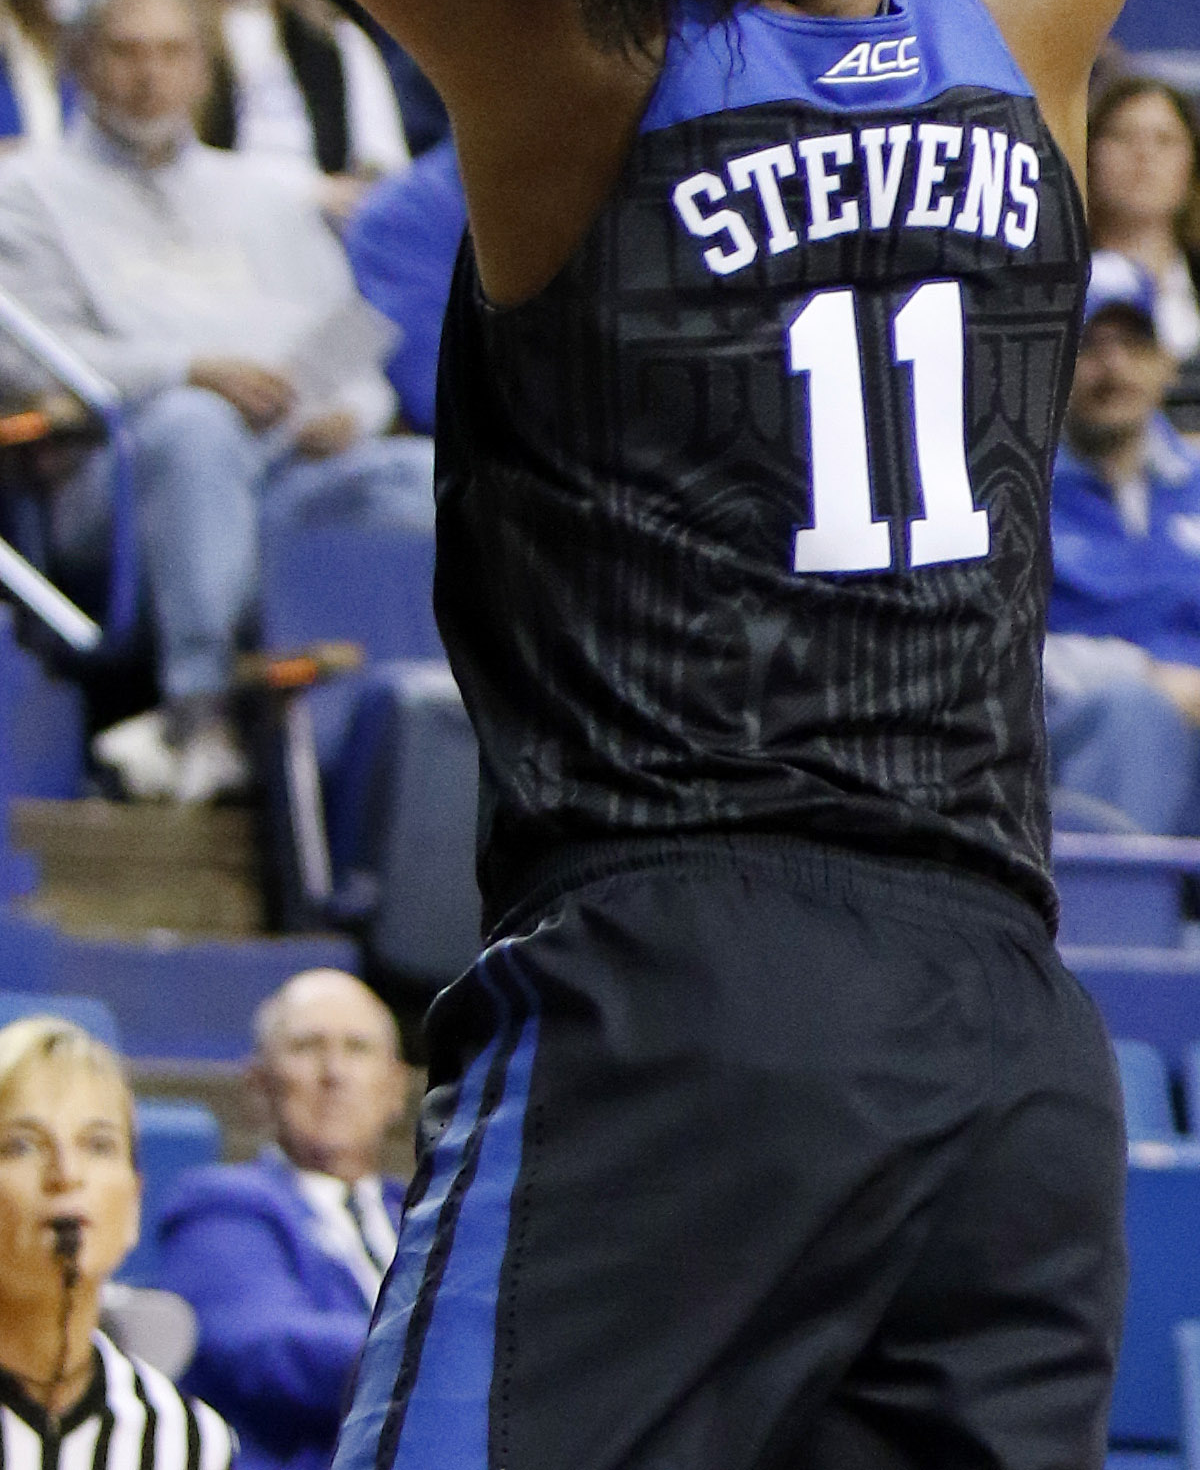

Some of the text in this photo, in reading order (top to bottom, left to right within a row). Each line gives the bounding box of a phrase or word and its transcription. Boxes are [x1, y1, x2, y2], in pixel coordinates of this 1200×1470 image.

[820, 36, 919, 79] ACC
[672, 124, 1040, 276] STEVENS
[788, 281, 990, 572] 11
